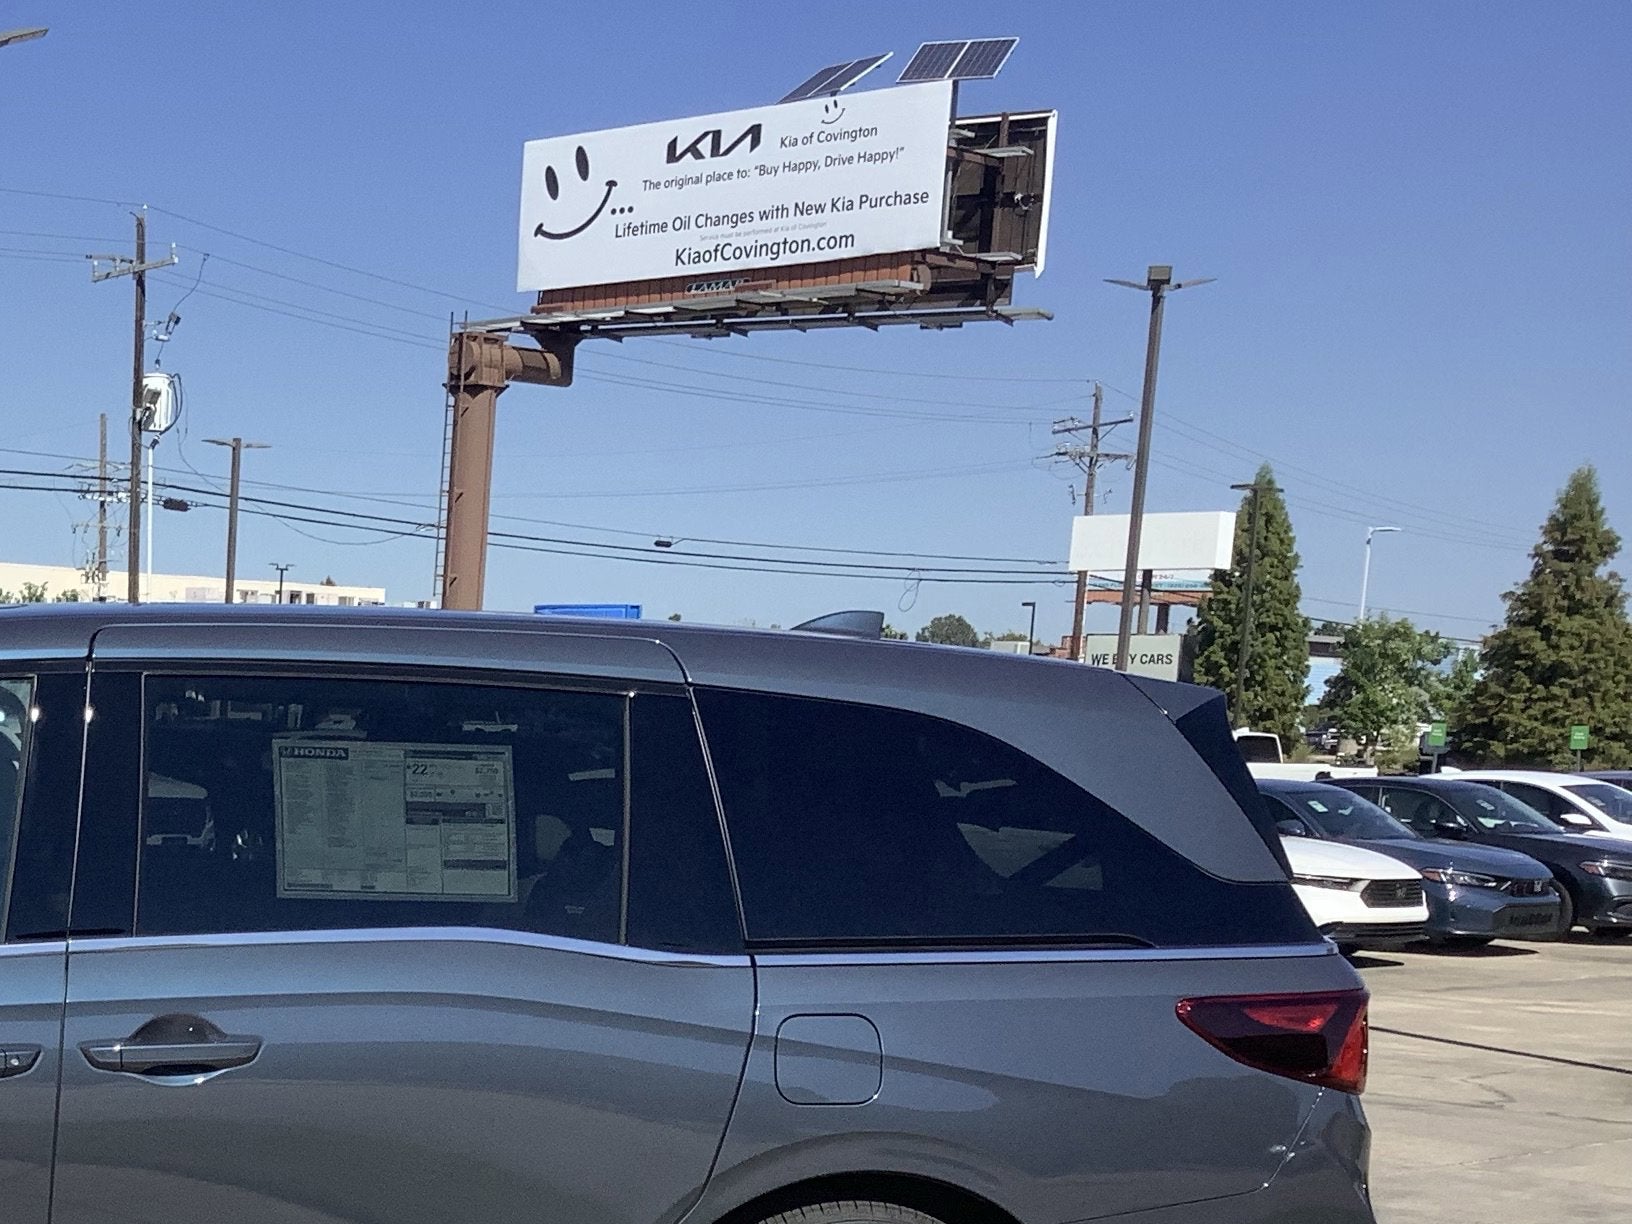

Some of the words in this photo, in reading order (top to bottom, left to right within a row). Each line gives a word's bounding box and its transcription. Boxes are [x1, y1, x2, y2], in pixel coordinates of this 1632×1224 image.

[780, 135, 798, 149] Kia
[801, 132, 814, 146] of
[817, 126, 878, 144] Covington
[642, 179, 662, 191] The
[663, 172, 703, 190] original
[705, 169, 734, 186] place
[736, 167, 751, 180] to:
[782, 158, 822, 174] Happy,
[824, 154, 854, 168] Drive
[614, 219, 668, 239] Lifetime
[672, 215, 691, 232] Oil
[694, 210, 755, 229] Changes
[758, 204, 789, 222] with
[793, 200, 827, 217] New
[831, 195, 854, 213] Kia
[858, 190, 929, 210] Purchase
[674, 233, 855, 267] KiaofCovington.com
[1091, 653, 1109, 666] WE
[1112, 653, 1137, 665] BY
[1140, 653, 1173, 665] CARS
[293, 746, 346, 758] HONDA
[411, 763, 428, 775] 22
